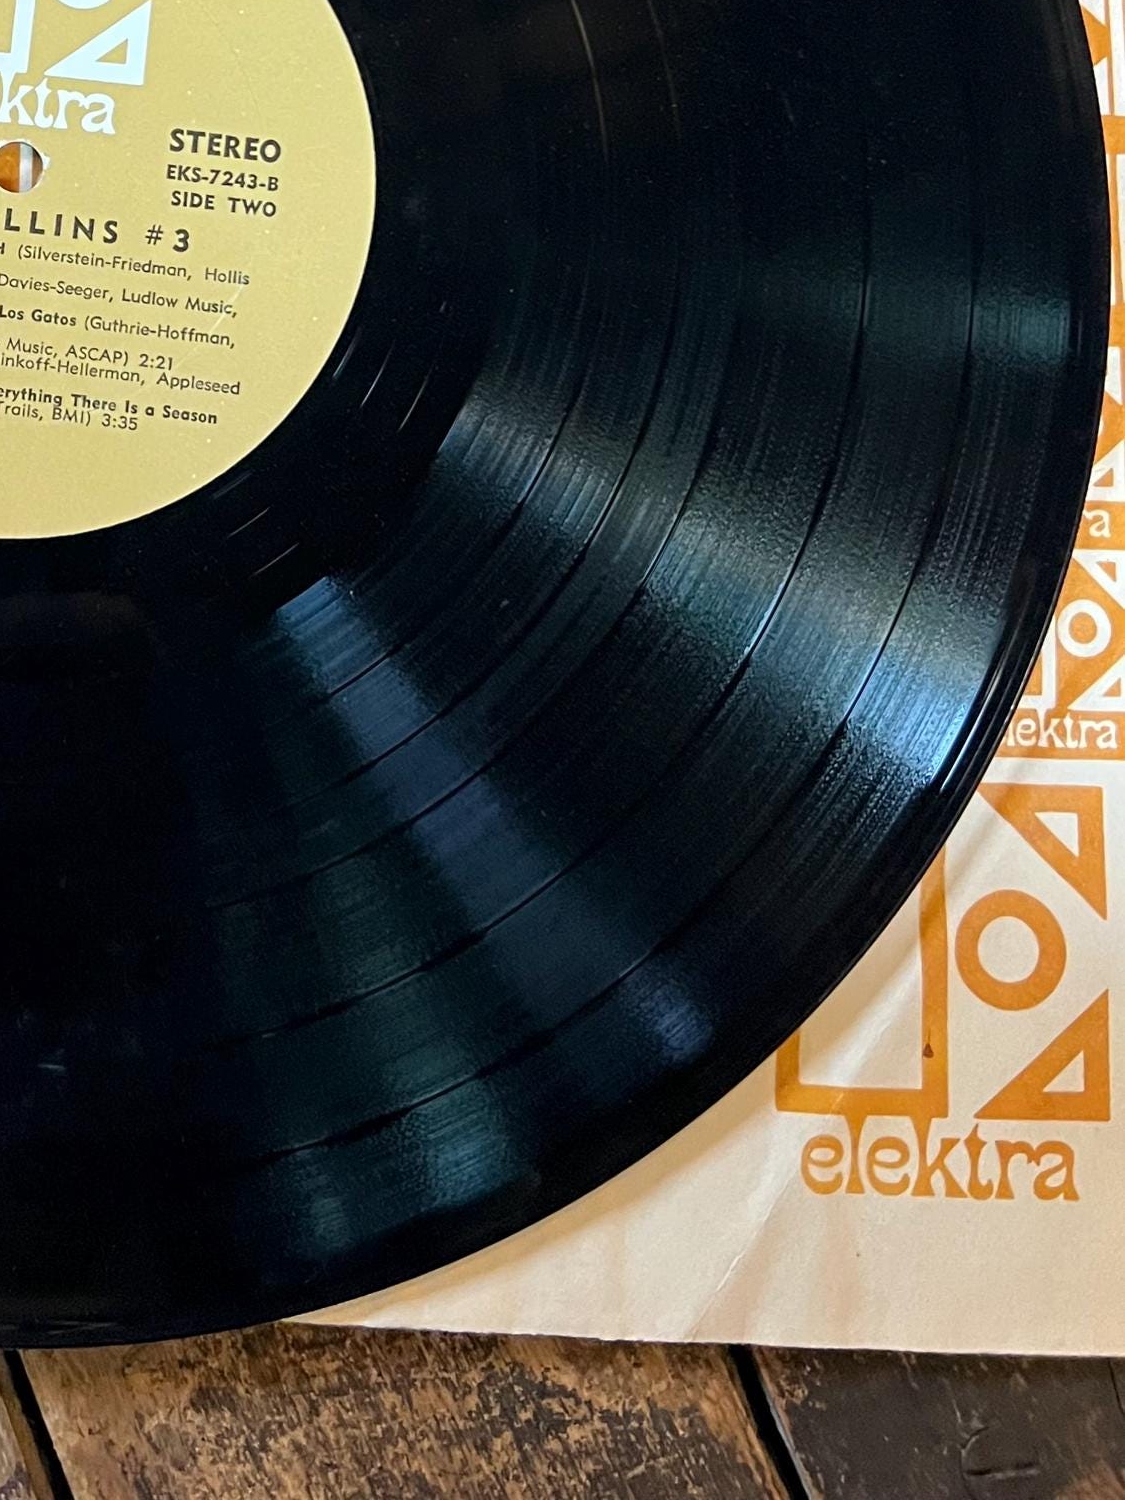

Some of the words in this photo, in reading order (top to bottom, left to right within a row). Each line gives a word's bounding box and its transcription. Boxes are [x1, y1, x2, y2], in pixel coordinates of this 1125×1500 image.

[169, 128, 282, 163] STEREO
[166, 165, 280, 193] EKS-7243-B
[171, 190, 214, 209] SIDE
[227, 196, 276, 217] TWO
[18, 244, 191, 281] (Silverstein-Friedman,
[204, 267, 249, 285] Hollis
[121, 288, 177, 307] Ludlow
[184, 296, 236, 318] Music,
[31, 308, 76, 326] Gatos
[84, 315, 234, 349] (Guthrie-Hoffman,
[6, 337, 57, 358] Music,
[65, 344, 128, 366] ASCAP)
[138, 353, 172, 370] 2:21
[156, 371, 240, 394] Appleseed
[51, 406, 90, 426] BMI)
[101, 413, 137, 430] 3:35
[70, 393, 116, 411] There
[125, 400, 137, 414] Is
[145, 406, 154, 416] a
[162, 404, 216, 424] Season
[800, 1115, 1079, 1201] elektra
